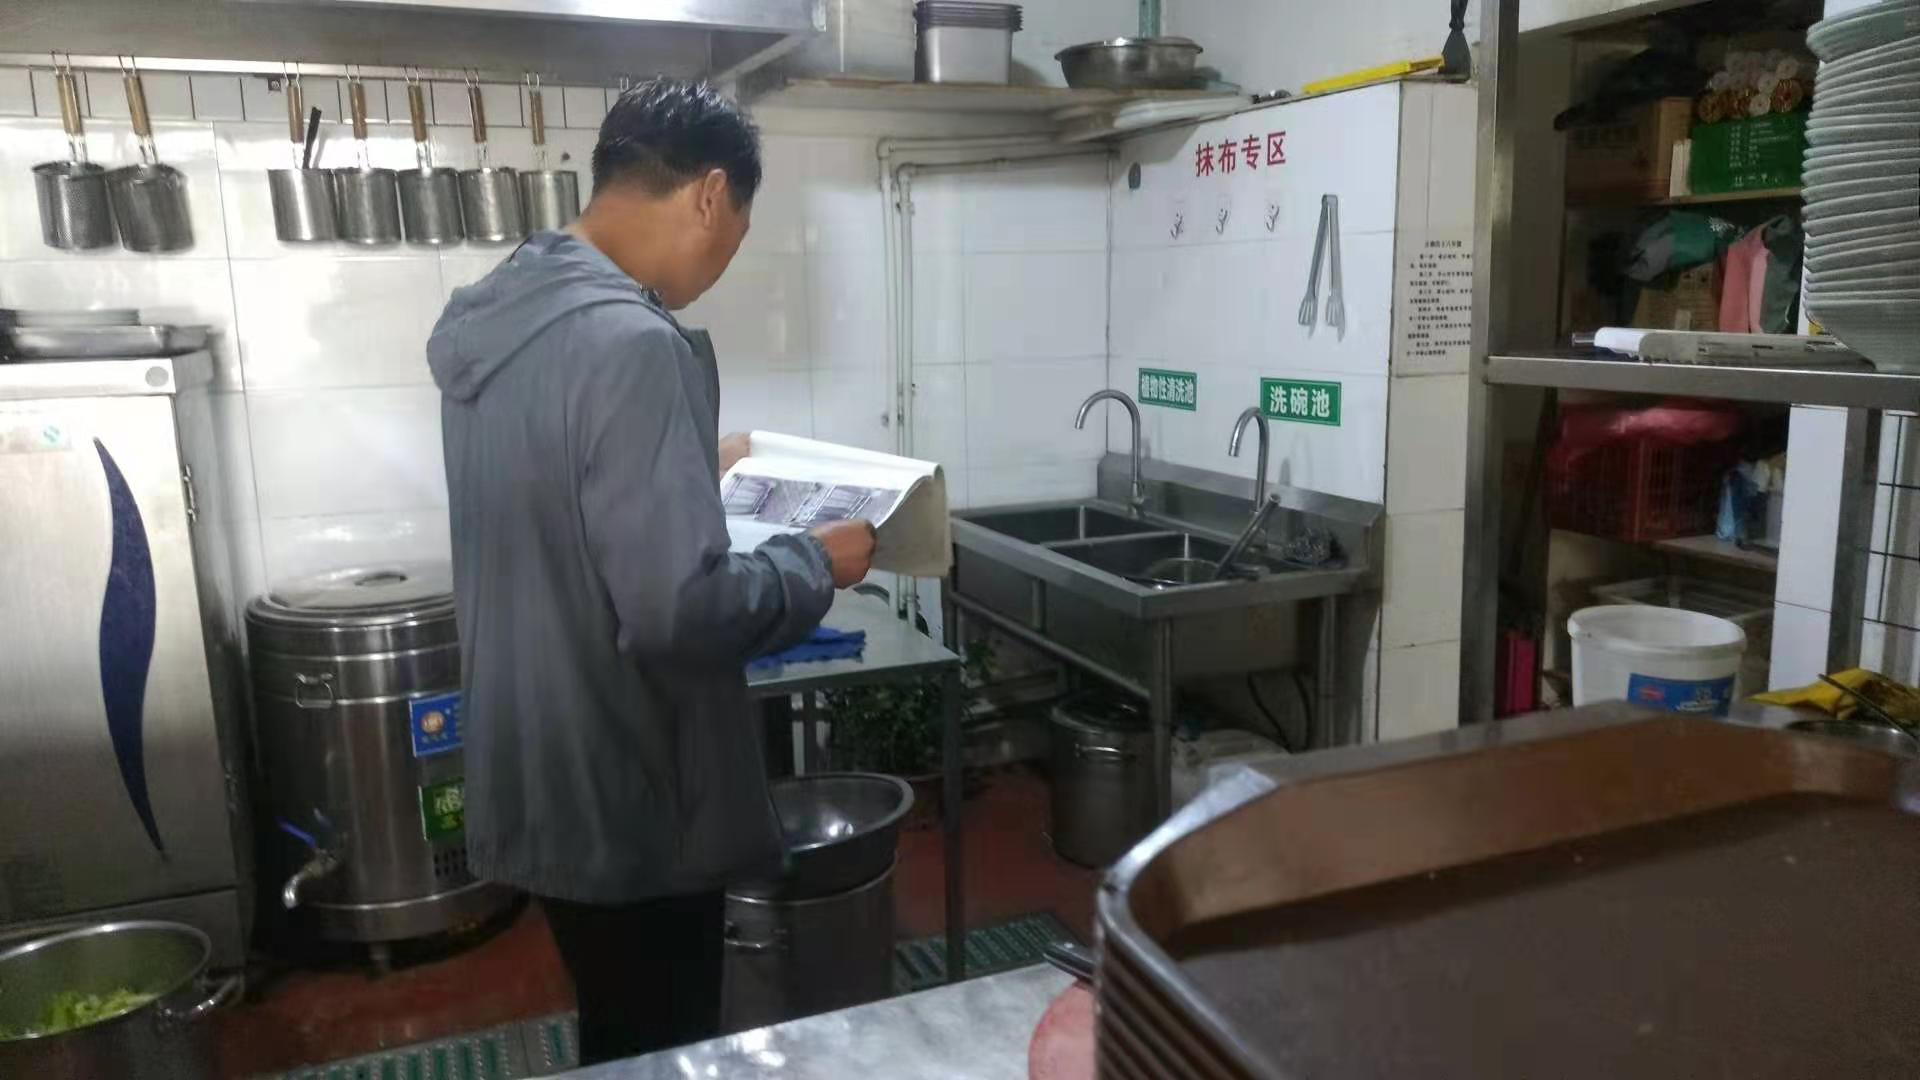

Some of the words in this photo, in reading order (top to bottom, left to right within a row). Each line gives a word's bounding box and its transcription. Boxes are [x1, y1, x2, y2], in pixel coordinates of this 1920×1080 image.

[1195, 131, 1286, 177] 抹布专区
[1270, 386, 1330, 417] 洗碗池
